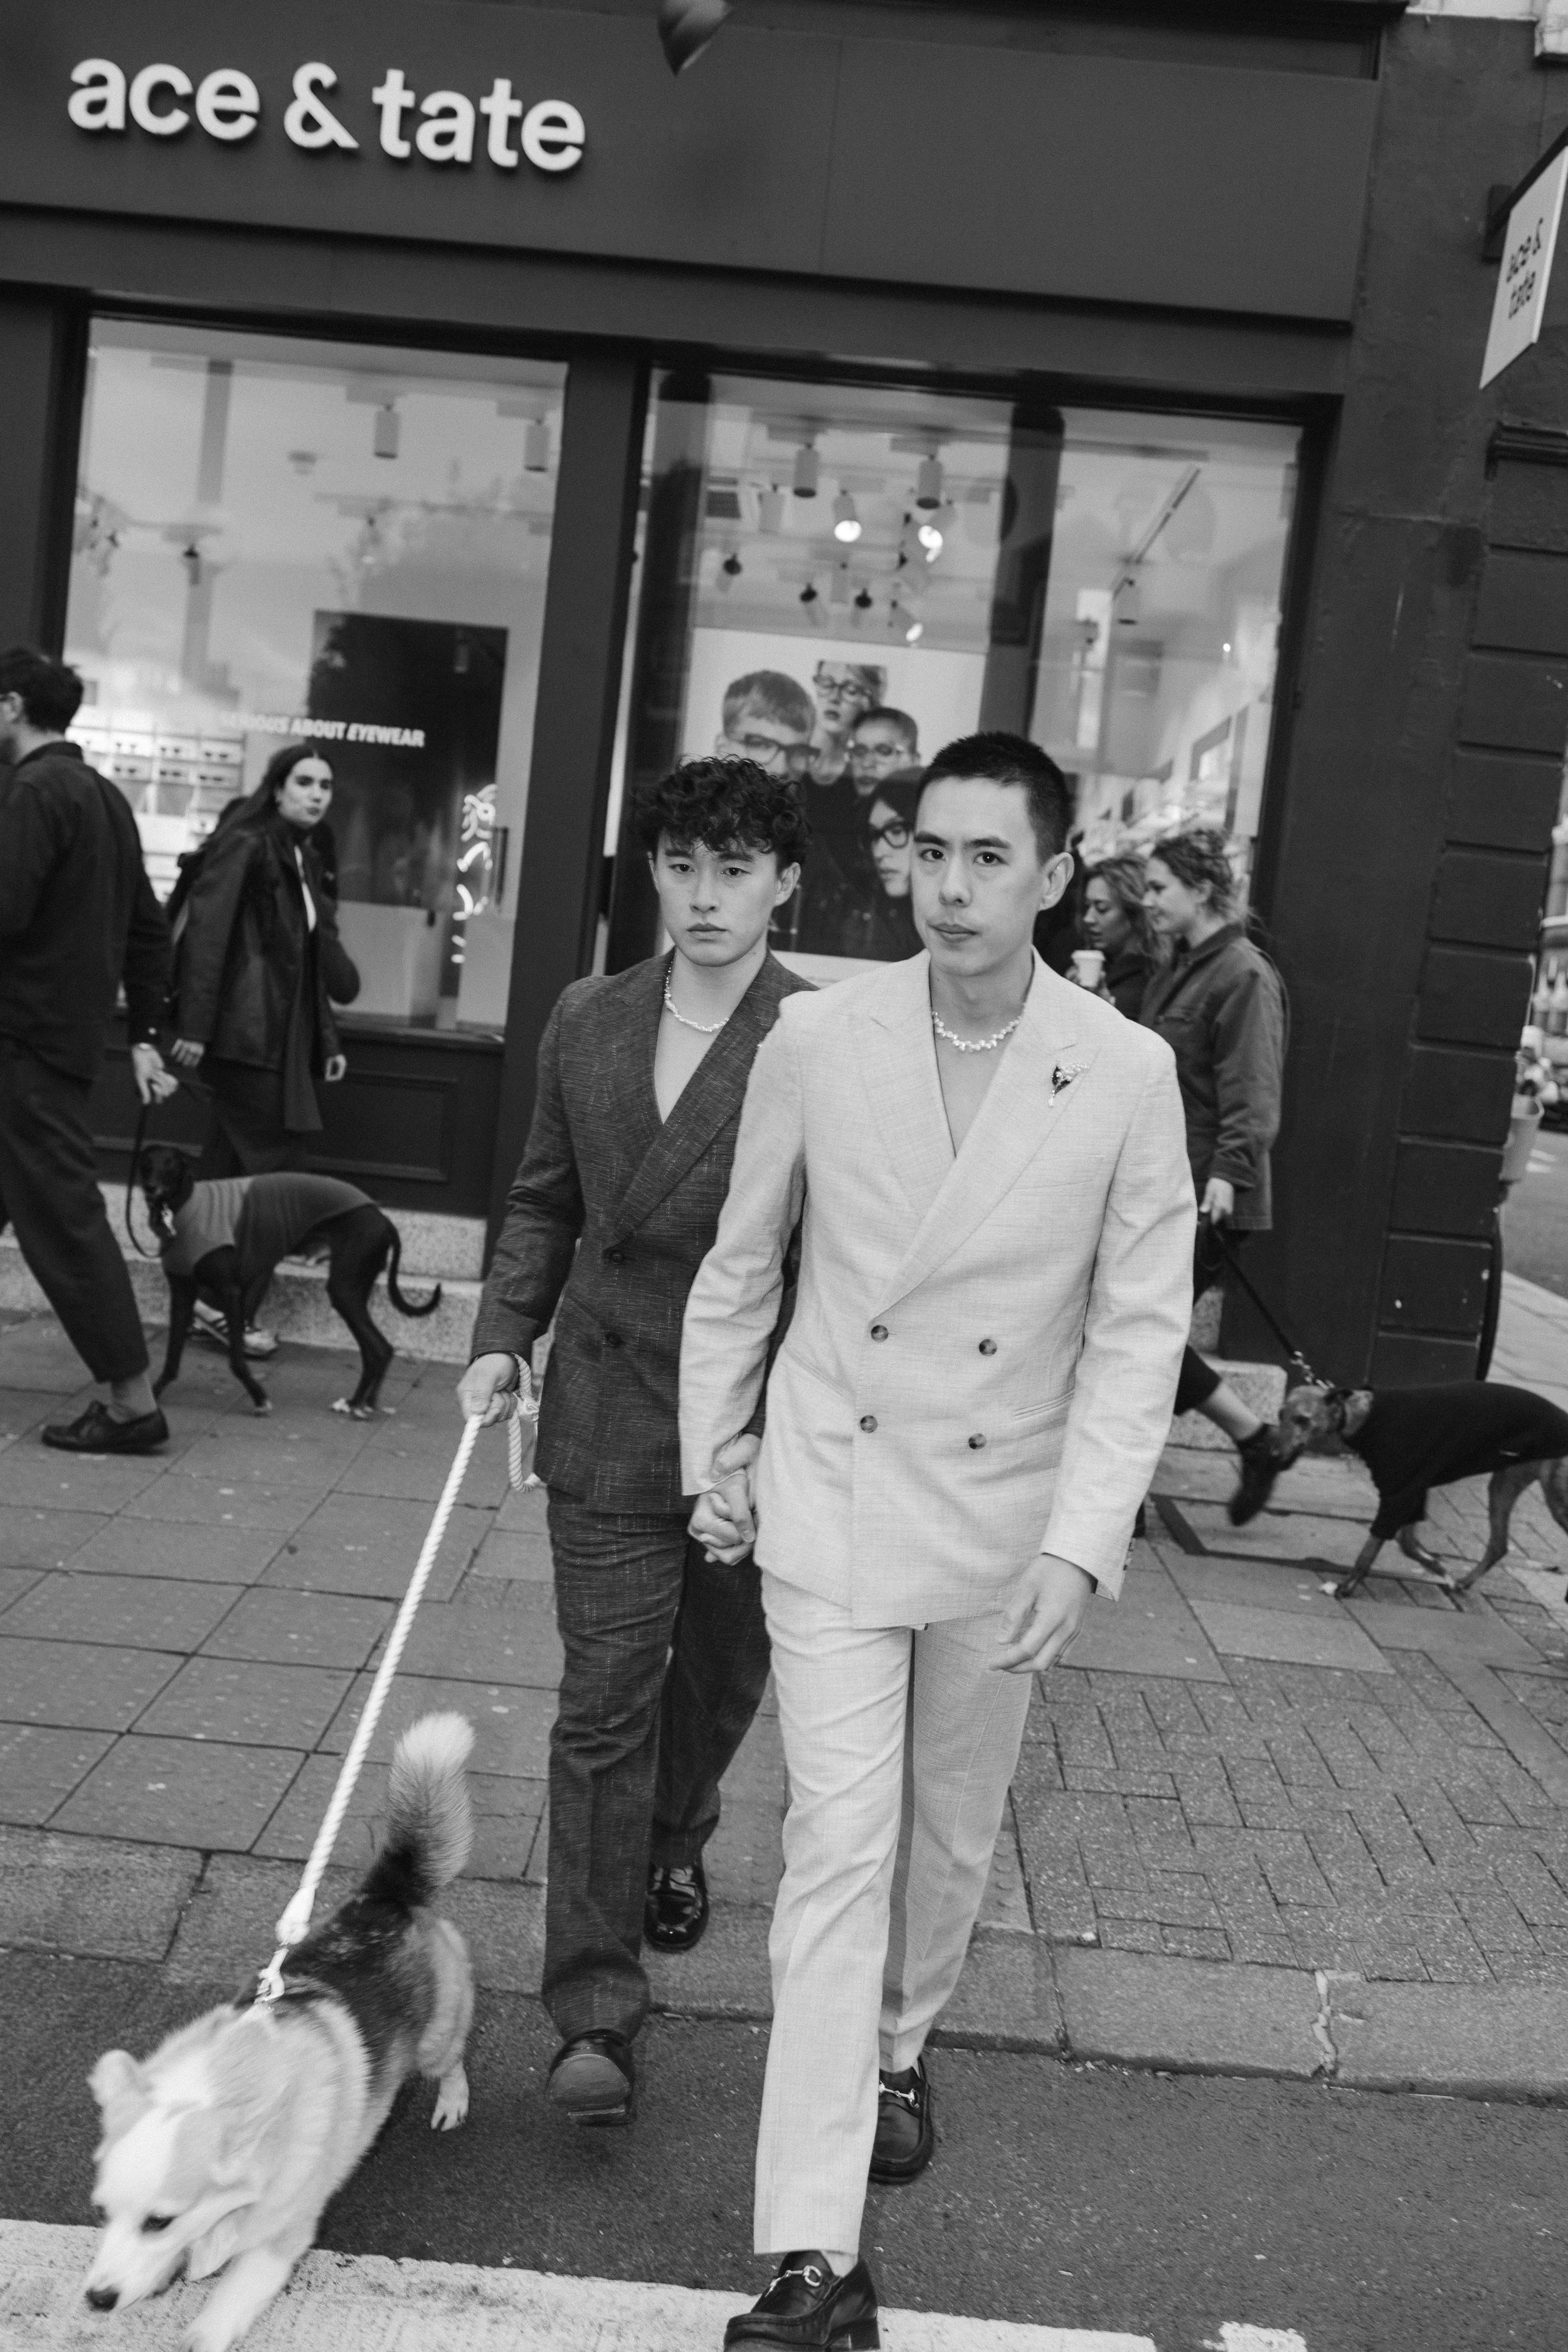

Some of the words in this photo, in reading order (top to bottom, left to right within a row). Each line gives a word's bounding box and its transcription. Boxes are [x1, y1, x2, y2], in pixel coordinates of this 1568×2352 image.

[68, 58, 260, 140] ace
[284, 61, 359, 149] &
[372, 68, 585, 171] tate
[290, 718, 347, 741] ABOUT
[346, 723, 425, 748] EYEWEAR
